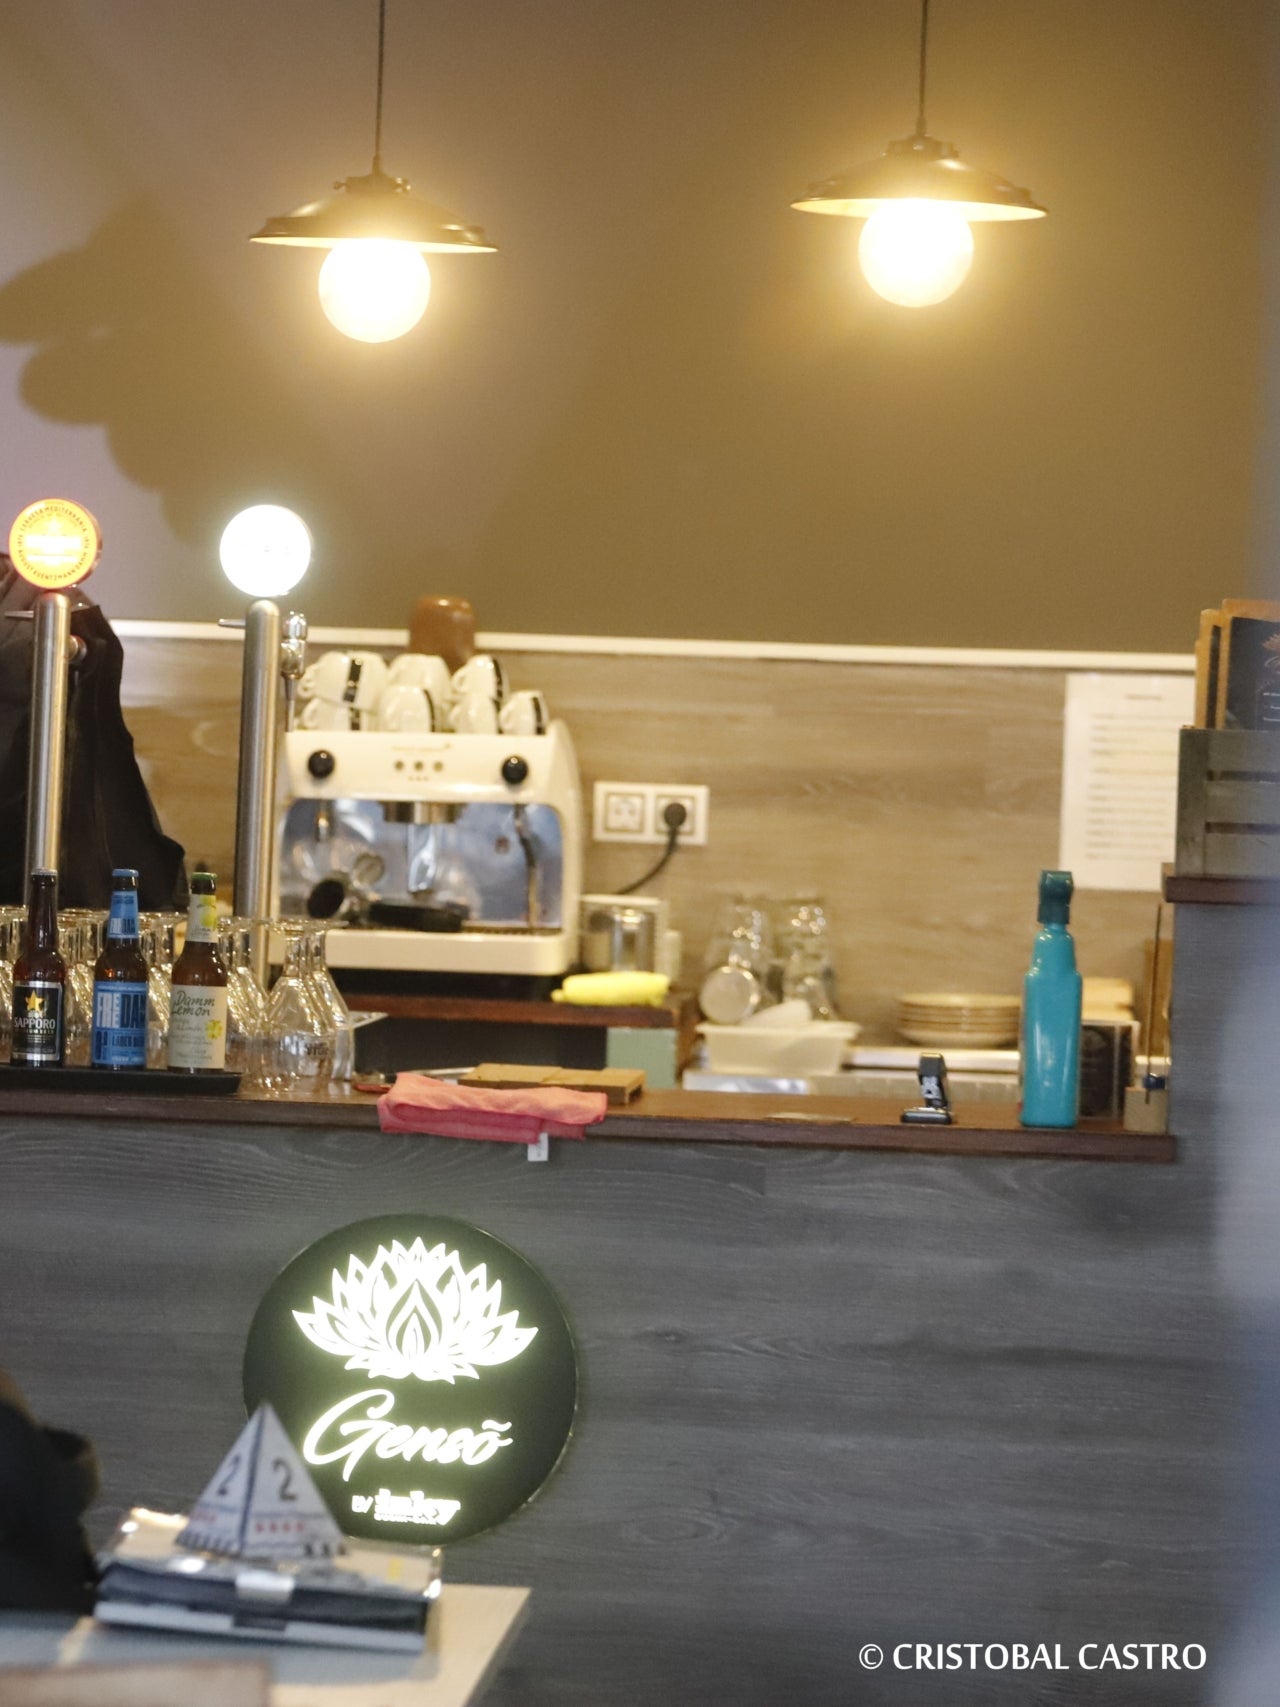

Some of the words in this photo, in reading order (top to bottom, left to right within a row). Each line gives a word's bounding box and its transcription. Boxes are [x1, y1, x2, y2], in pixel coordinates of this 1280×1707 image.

[173, 990, 216, 1007] Damm
[14, 1016, 56, 1030] SAPPORO
[273, 1458, 298, 1501] 2
